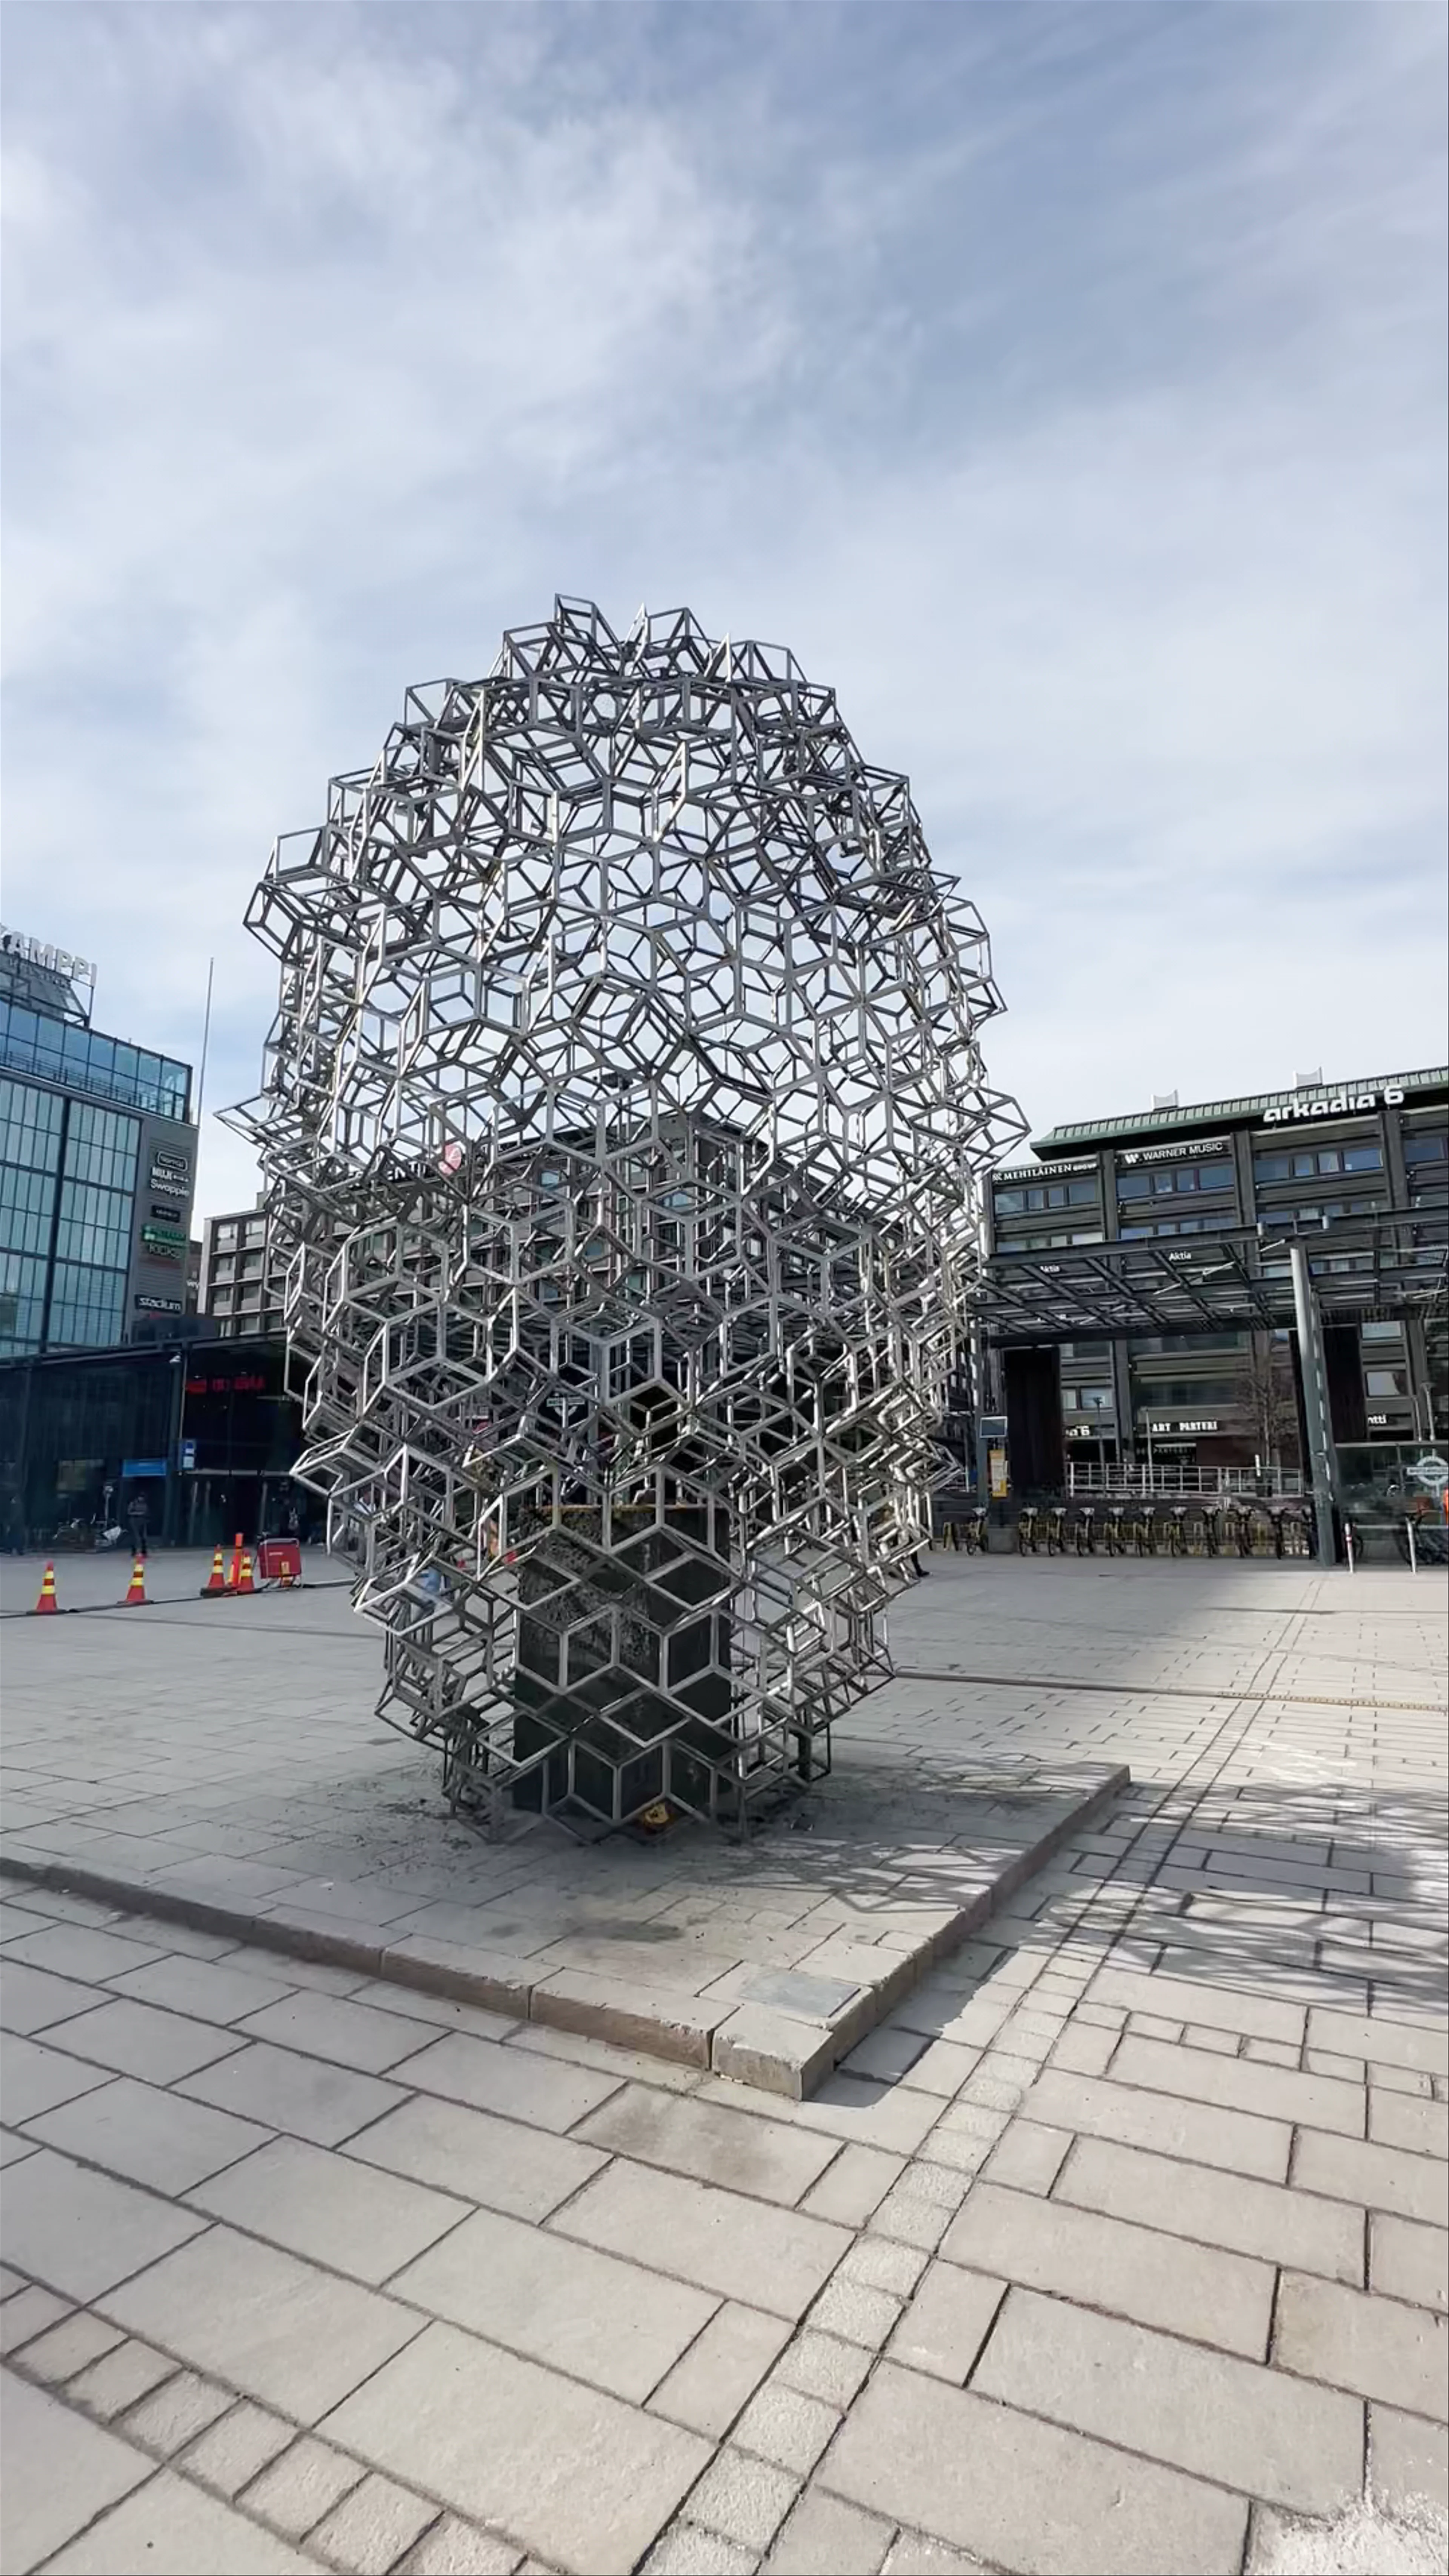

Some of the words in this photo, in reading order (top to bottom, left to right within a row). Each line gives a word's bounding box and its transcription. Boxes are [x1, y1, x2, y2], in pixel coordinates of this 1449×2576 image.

[1263, 1090, 1377, 1123] arkadia
[1384, 1084, 1404, 1105] 6
[1142, 1147, 1186, 1161] WARNER
[1189, 1142, 1223, 1155] MUSIC
[1004, 1163, 1072, 1181] MEHILÄINEN
[1169, 1250, 1191, 1261] Aktia
[1152, 1423, 1171, 1432] ART
[1179, 1421, 1217, 1431] PARTURI
